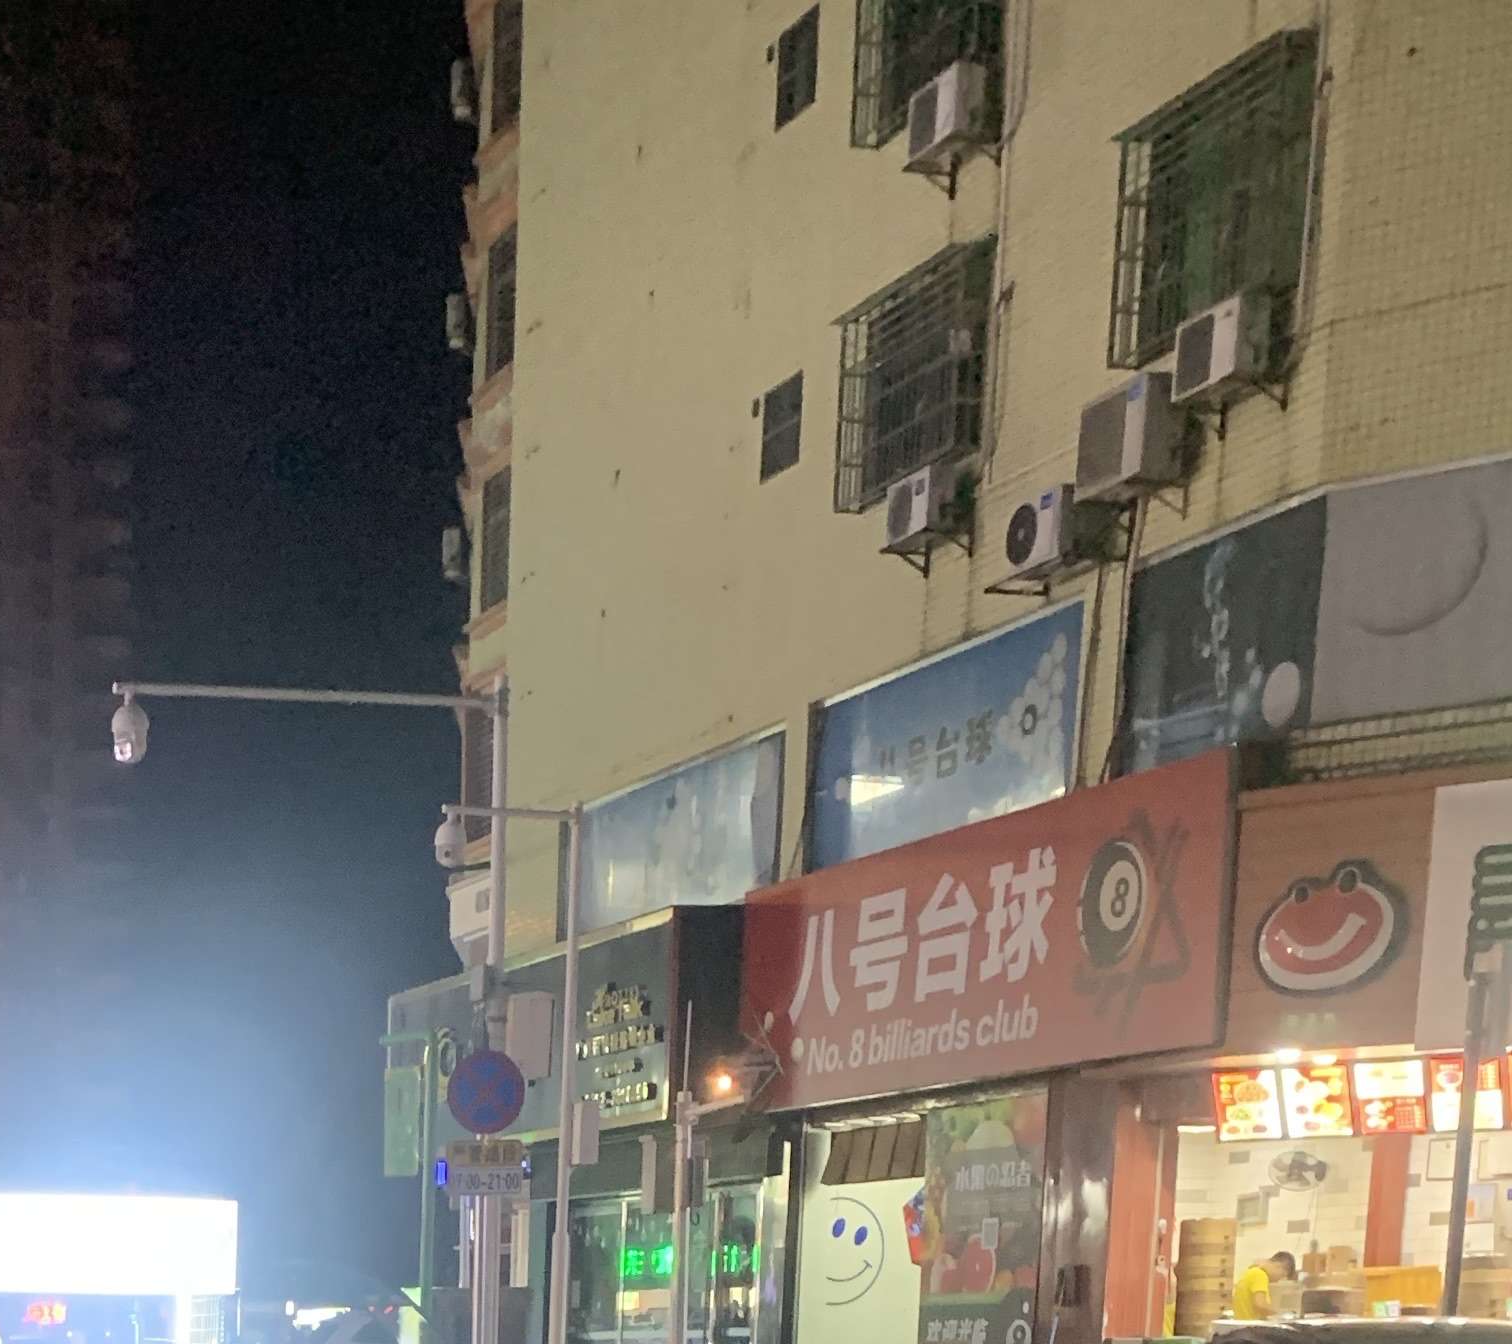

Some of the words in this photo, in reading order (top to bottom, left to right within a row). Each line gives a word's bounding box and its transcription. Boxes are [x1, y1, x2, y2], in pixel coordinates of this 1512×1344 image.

[879, 710, 993, 786] 八号台球
[789, 845, 1058, 1024] 八号台球
[806, 1036, 844, 1076] No.
[849, 1029, 865, 1068] 8
[867, 1008, 970, 1065] billiards
[975, 993, 1039, 1046] club
